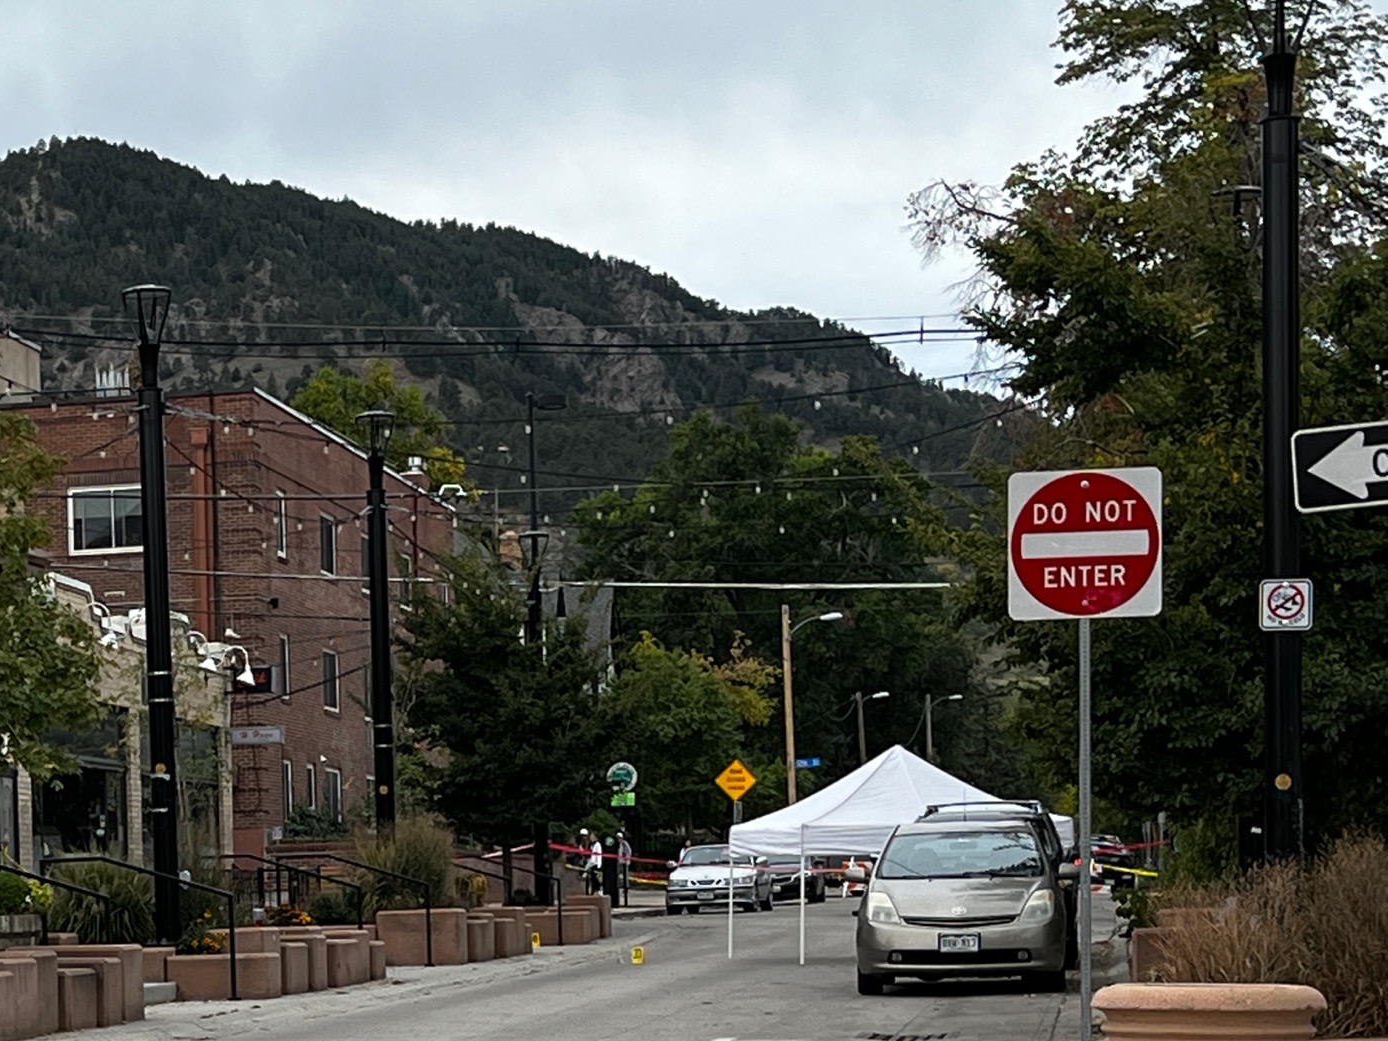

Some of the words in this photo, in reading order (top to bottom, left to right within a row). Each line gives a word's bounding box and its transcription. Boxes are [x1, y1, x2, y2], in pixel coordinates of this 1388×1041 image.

[1033, 502, 1067, 525] DO
[1085, 500, 1137, 523] NOT
[1044, 564, 1126, 588] ENTER
